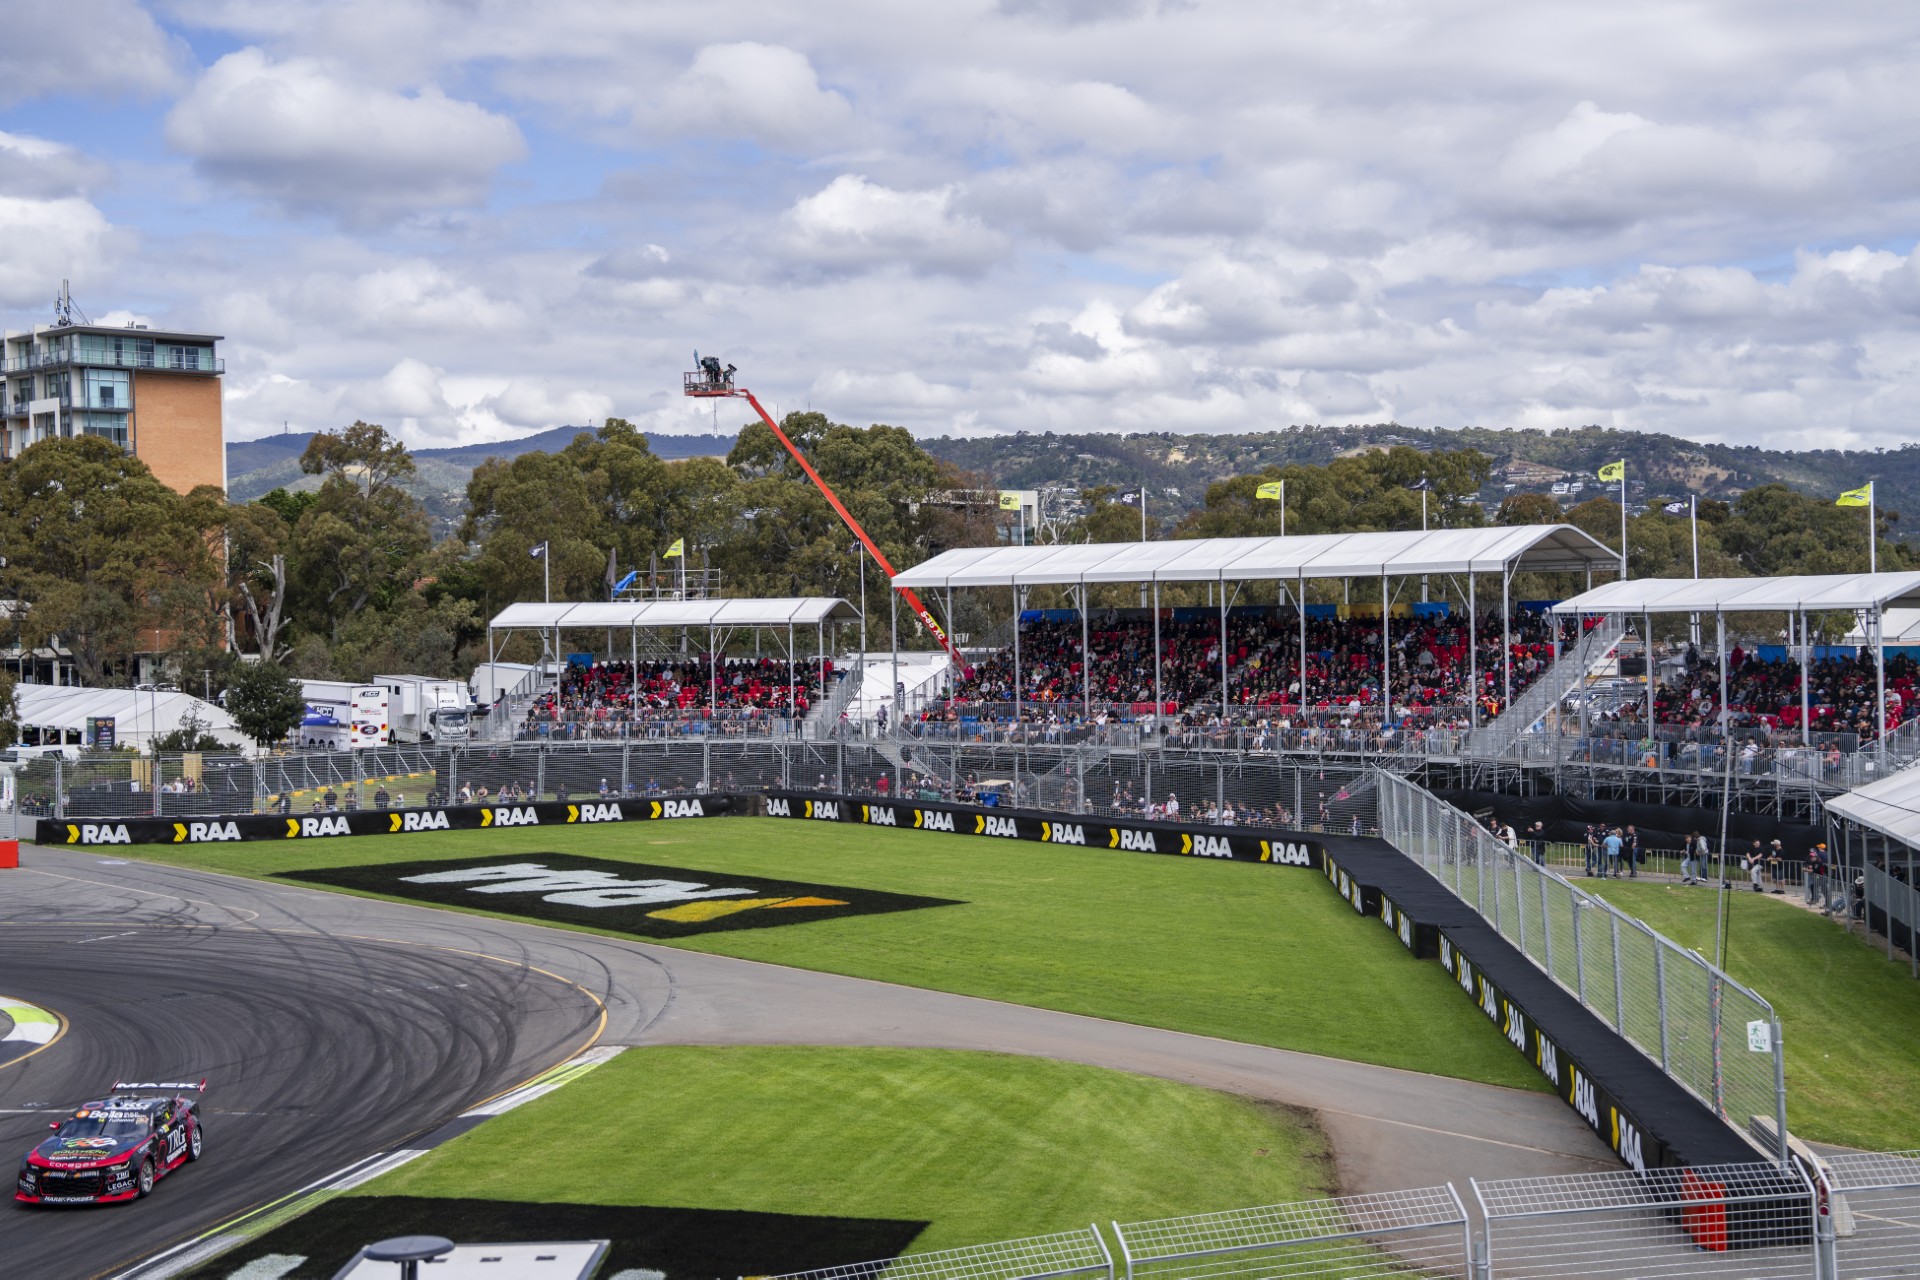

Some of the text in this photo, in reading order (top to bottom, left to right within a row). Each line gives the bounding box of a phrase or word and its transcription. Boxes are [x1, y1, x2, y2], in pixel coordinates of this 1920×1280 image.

[933, 629, 945, 640] XC
[495, 807, 539, 826] RAA
[580, 803, 623, 822] RAA
[664, 799, 705, 818] RAA
[870, 805, 897, 825] RAA
[191, 821, 241, 842] RAA
[302, 816, 351, 837] RAA
[405, 811, 450, 831] RAA
[924, 811, 954, 832] RAA
[986, 815, 1017, 837] RAA
[82, 824, 131, 844] RAA
[1053, 822, 1085, 844] RAA
[1121, 829, 1156, 852] RAA
[1194, 835, 1232, 858] RAA
[1273, 842, 1309, 866] RAA
[397, 862, 760, 908] RAA
[1482, 978, 1497, 1022] RAA
[1508, 1003, 1526, 1052] RAA
[1540, 1033, 1559, 1086] RAA
[1575, 1069, 1599, 1130] RAA
[88, 1110, 124, 1119] Bella
[167, 1123, 186, 1155] TRG
[1619, 1113, 1647, 1181] RAA
[107, 1177, 137, 1191] LEGACY
